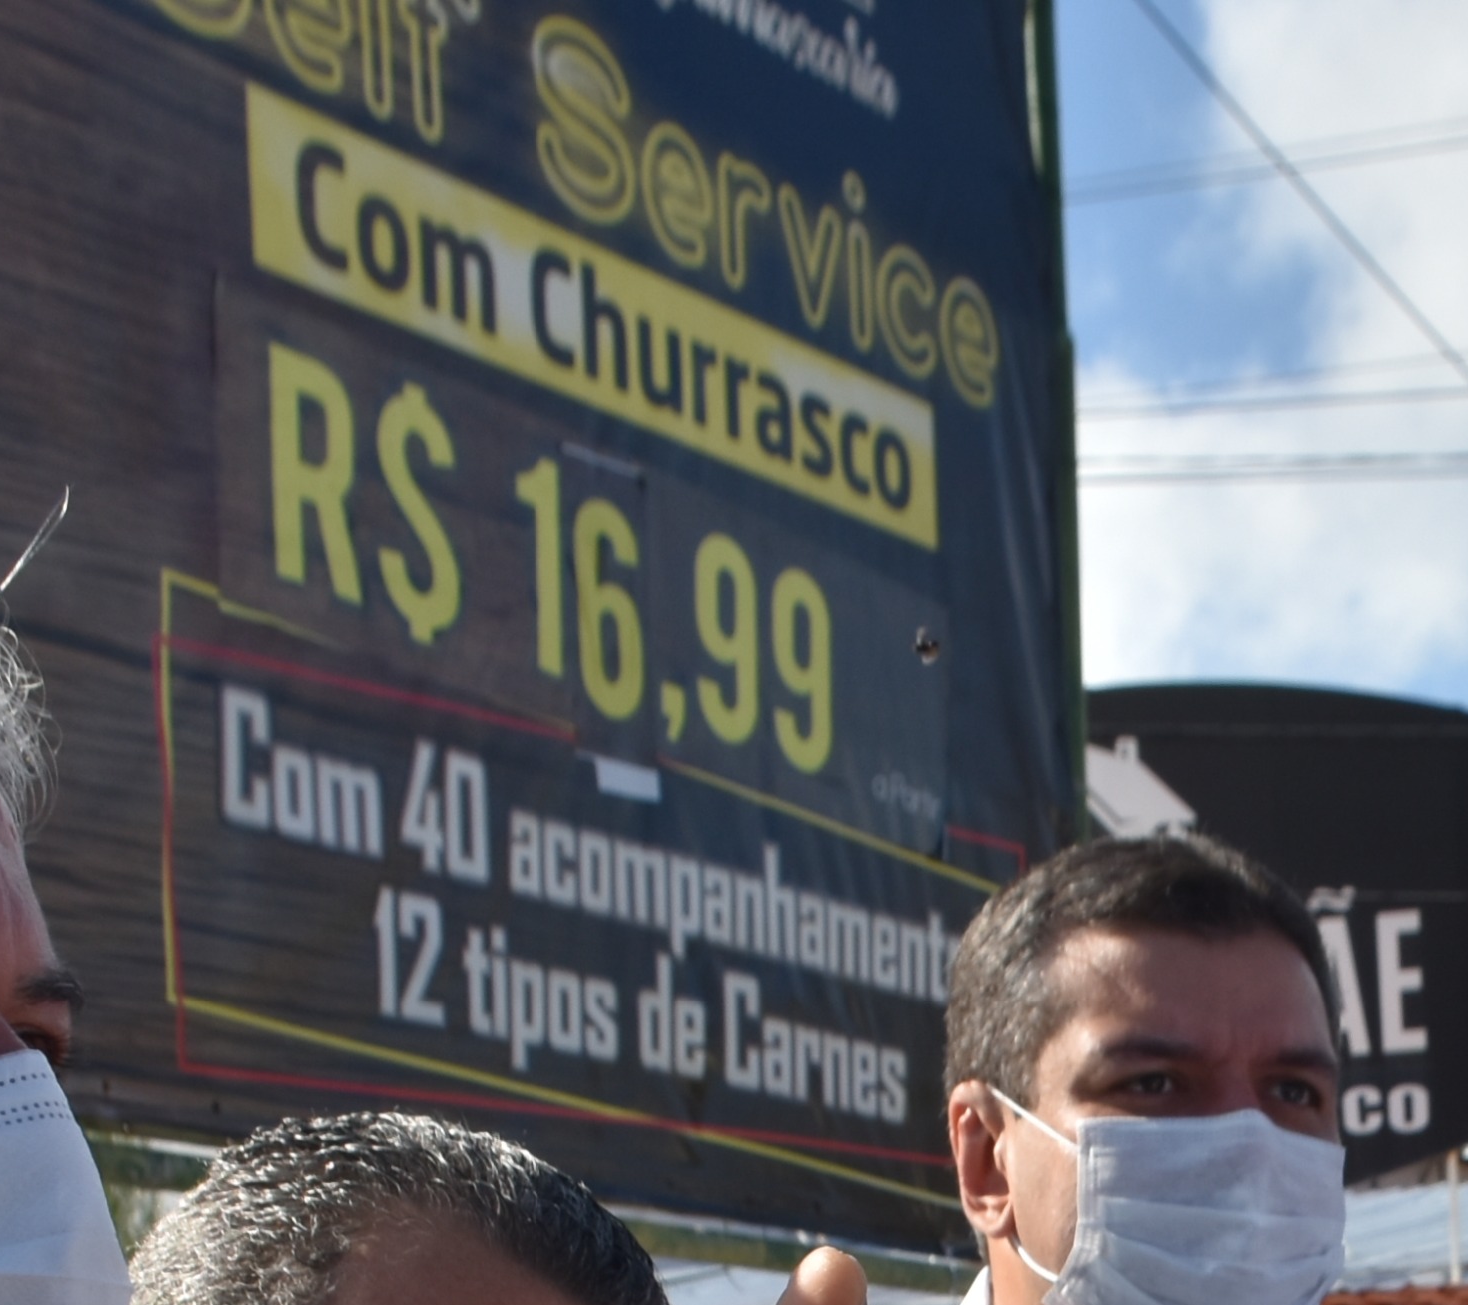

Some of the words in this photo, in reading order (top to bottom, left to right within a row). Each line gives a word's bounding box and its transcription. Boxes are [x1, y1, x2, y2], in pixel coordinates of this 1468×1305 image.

[156, 0, 449, 141] elf
[532, 16, 1000, 407] Service
[294, 141, 498, 336] Com
[532, 248, 914, 512] Churrasco
[268, 342, 462, 646] R$
[516, 457, 833, 775] 16,99
[219, 684, 384, 861] Com
[400, 738, 489, 885] 40
[374, 887, 446, 1028] 12
[463, 924, 620, 1073] tipos
[637, 950, 706, 1080] de
[724, 971, 909, 1128] Carnes
[1307, 884, 1430, 1057] ÃE
[1342, 1083, 1430, 1136] CO
